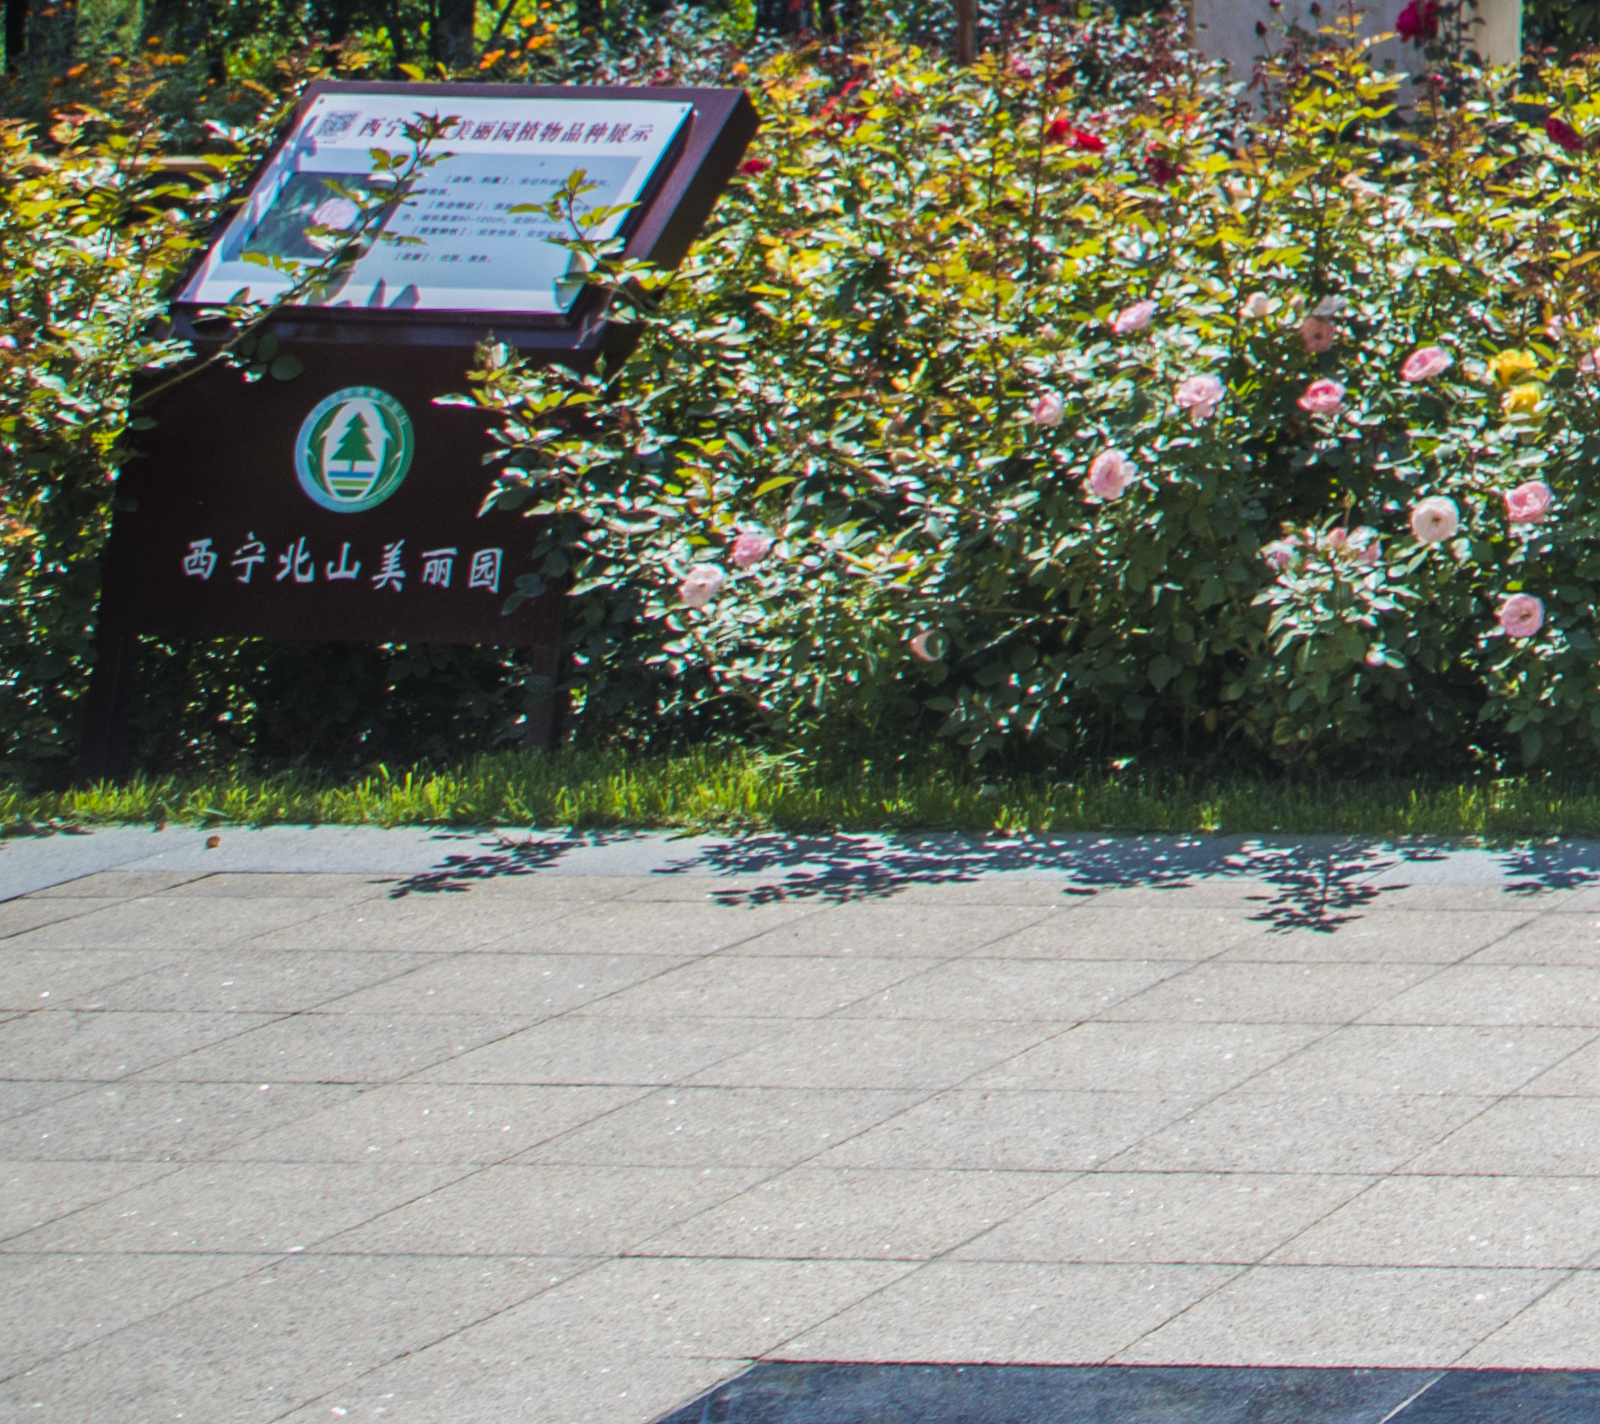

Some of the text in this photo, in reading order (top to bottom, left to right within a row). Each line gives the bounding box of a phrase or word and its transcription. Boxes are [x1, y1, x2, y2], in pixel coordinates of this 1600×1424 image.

[358, 117, 653, 144] 西宁美丽园植物品种展示
[183, 532, 503, 593] 西宁北山美丽园
